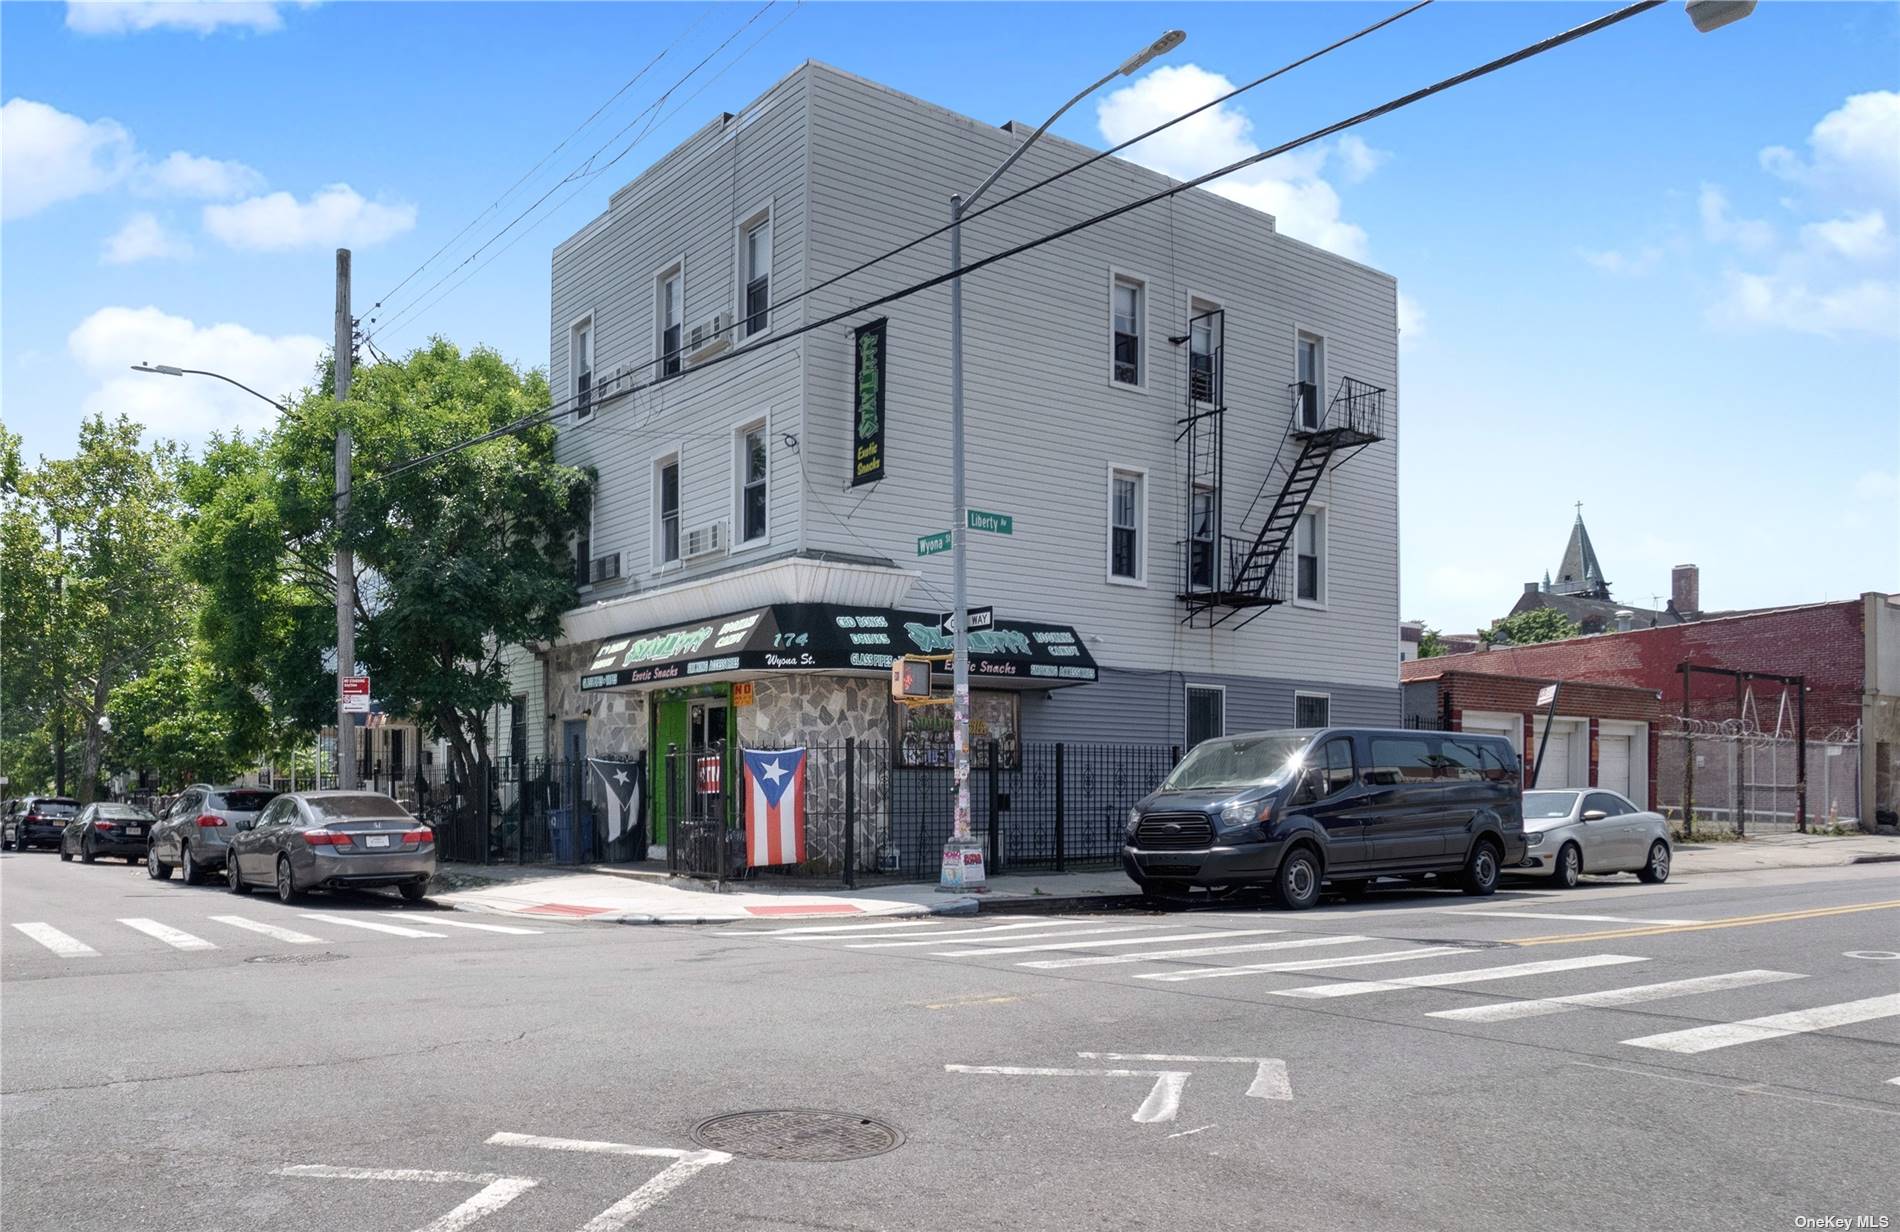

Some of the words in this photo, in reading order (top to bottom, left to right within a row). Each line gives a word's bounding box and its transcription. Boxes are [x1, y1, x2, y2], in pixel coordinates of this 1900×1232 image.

[857, 441, 878, 460] Exotic
[857, 457, 880, 475] Snacks
[971, 513, 998, 532] Liberty
[919, 538, 943, 554] Wyona
[856, 616, 888, 628] BONGS
[972, 614, 988, 625] WAY
[773, 632, 808, 648] 174
[849, 633, 890, 645] DRINKS
[765, 654, 797, 668] Wyona
[800, 653, 816, 665] St.
[850, 652, 874, 666] GLASS
[874, 654, 893, 667] PIPES
[980, 660, 1017, 674] Snacks
[632, 670, 652, 682] Exotic
[653, 665, 678, 679] Snacks
